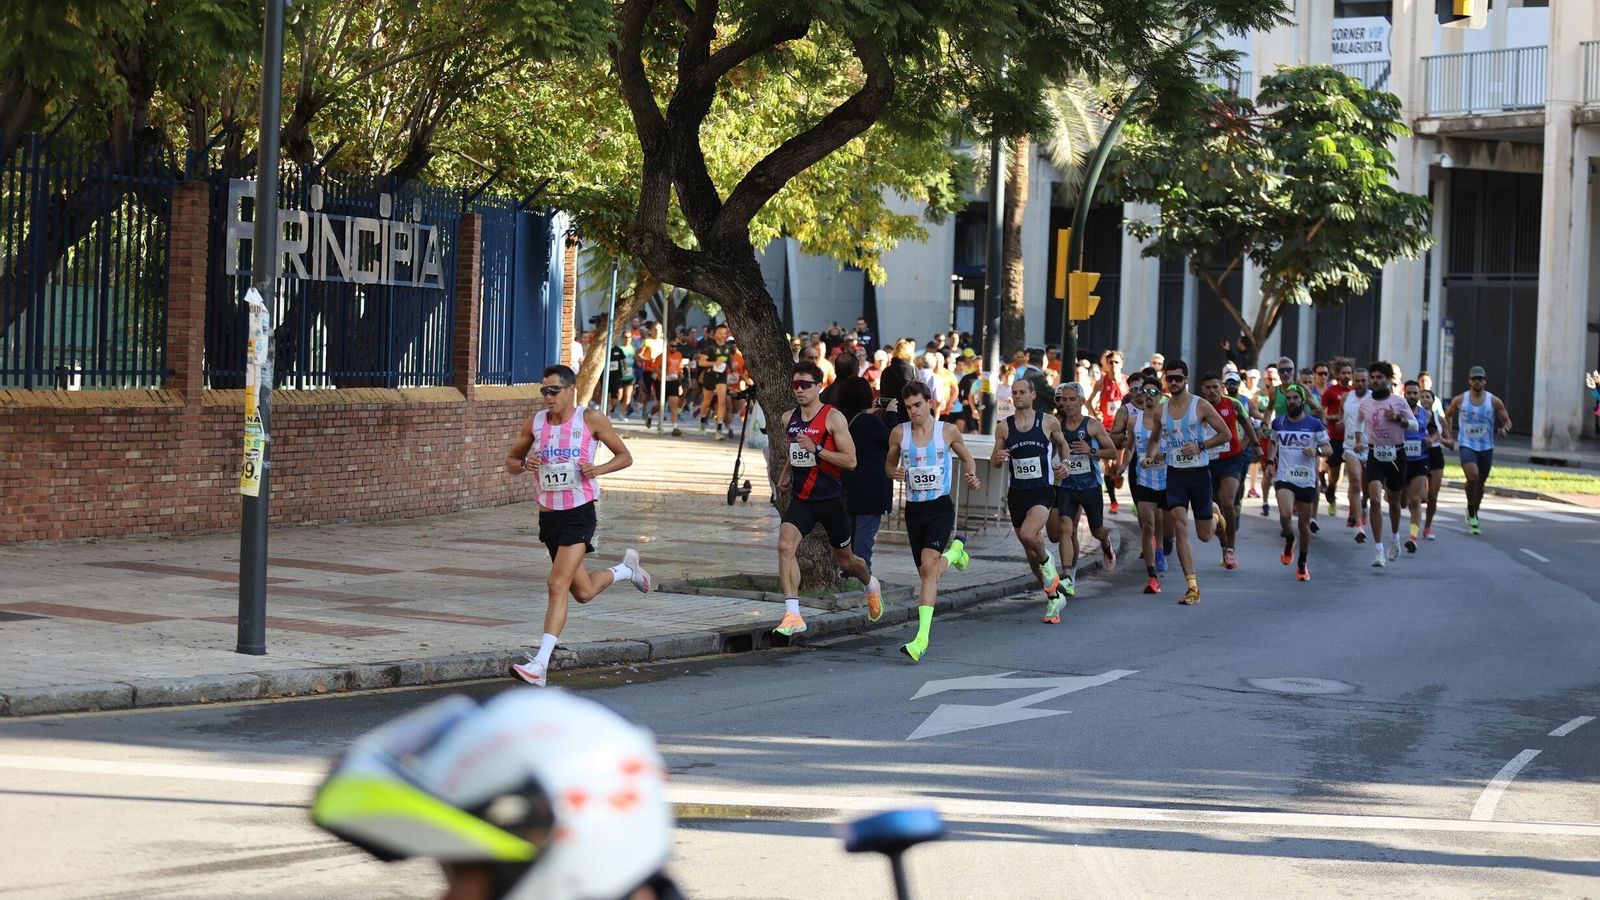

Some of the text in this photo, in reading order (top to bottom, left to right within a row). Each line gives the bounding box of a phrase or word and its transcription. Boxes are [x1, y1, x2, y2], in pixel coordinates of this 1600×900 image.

[1332, 27, 1366, 40] CORNER
[1332, 41, 1383, 54] MALAGUISTA
[792, 451, 810, 460] 694
[1016, 465, 1037, 474] 390
[544, 472, 568, 484] 117
[914, 474, 936, 484] 330
